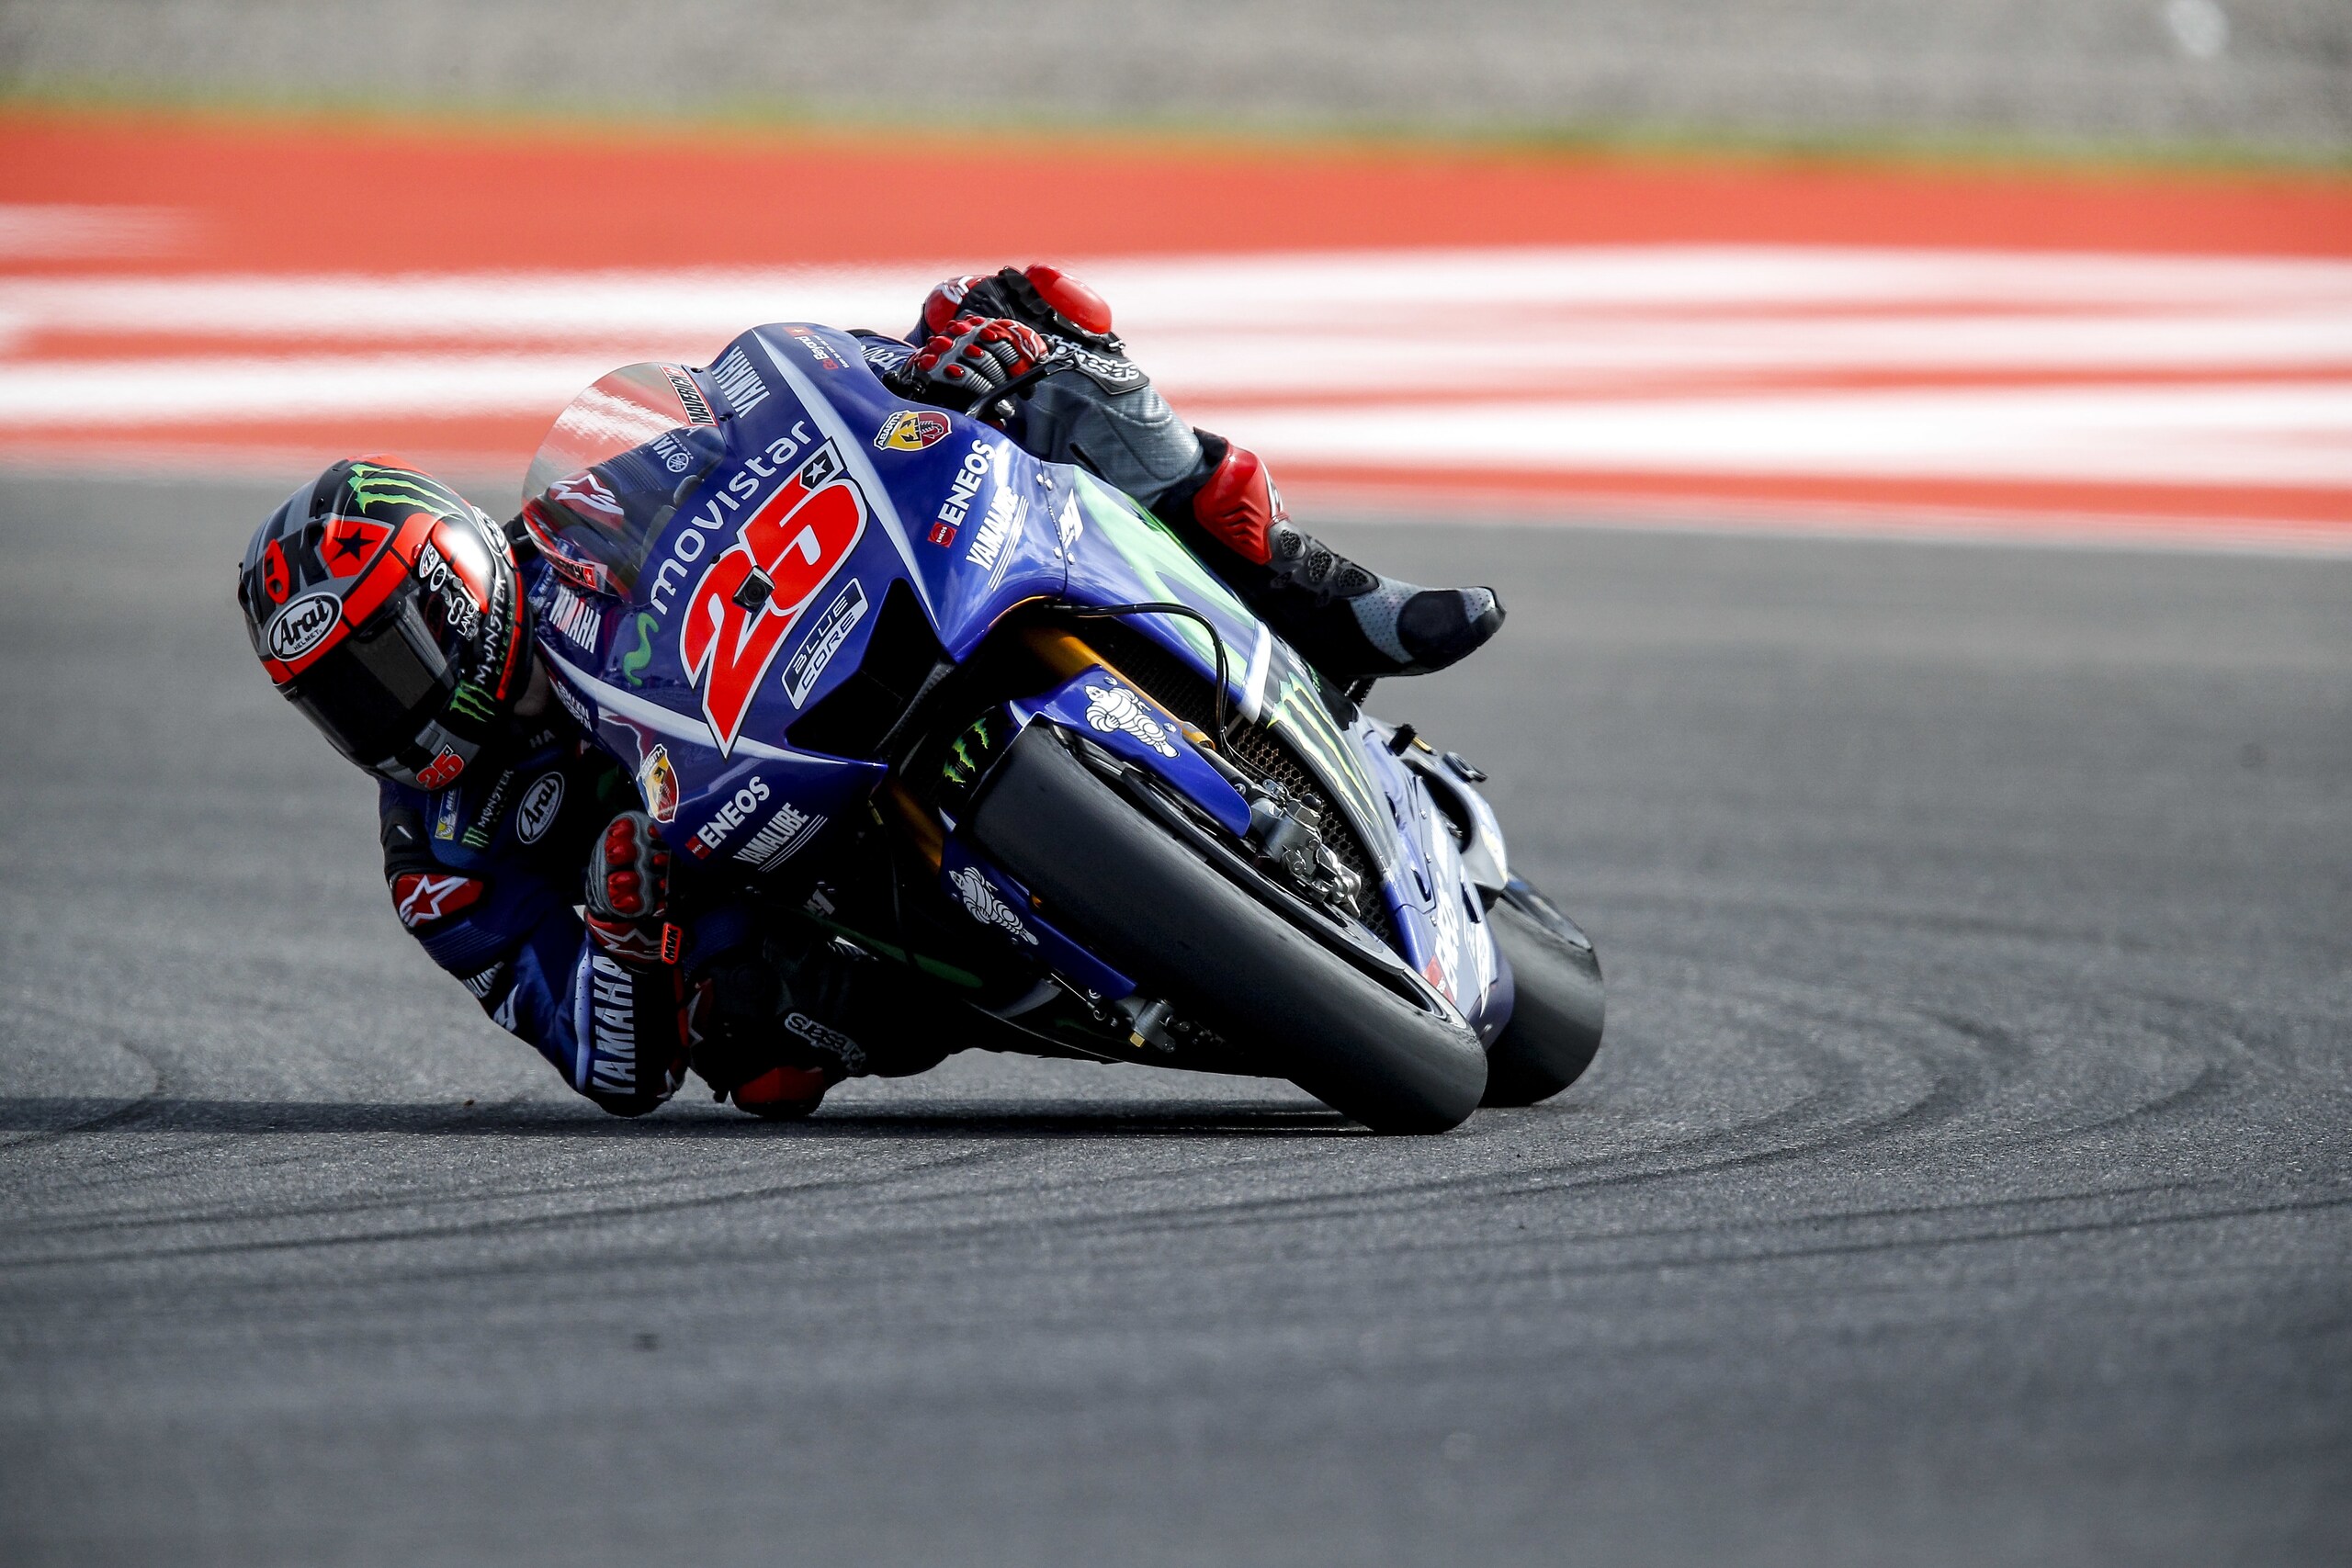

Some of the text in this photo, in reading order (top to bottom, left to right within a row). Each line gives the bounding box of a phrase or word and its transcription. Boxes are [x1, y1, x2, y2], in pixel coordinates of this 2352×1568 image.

[711, 345, 771, 419] YAMAHA
[876, 412, 903, 446] ABARTH
[937, 438, 996, 527] ENEOS
[650, 420, 812, 615] movistar
[936, 526, 947, 544] ENEOS
[277, 596, 330, 656] Arai
[474, 579, 507, 685] MONSTER
[680, 437, 868, 761] 25
[293, 628, 321, 651] HELMET
[793, 595, 849, 675] BLUE
[801, 614, 856, 691] CORE
[415, 744, 465, 790] 25
[478, 769, 514, 828] MONSTER
[522, 776, 558, 840] Arai
[698, 776, 770, 850] ENEOS
[733, 802, 810, 864] YAMALUBE
[663, 926, 679, 961] MVK
[592, 954, 637, 1095] YAMAHA
